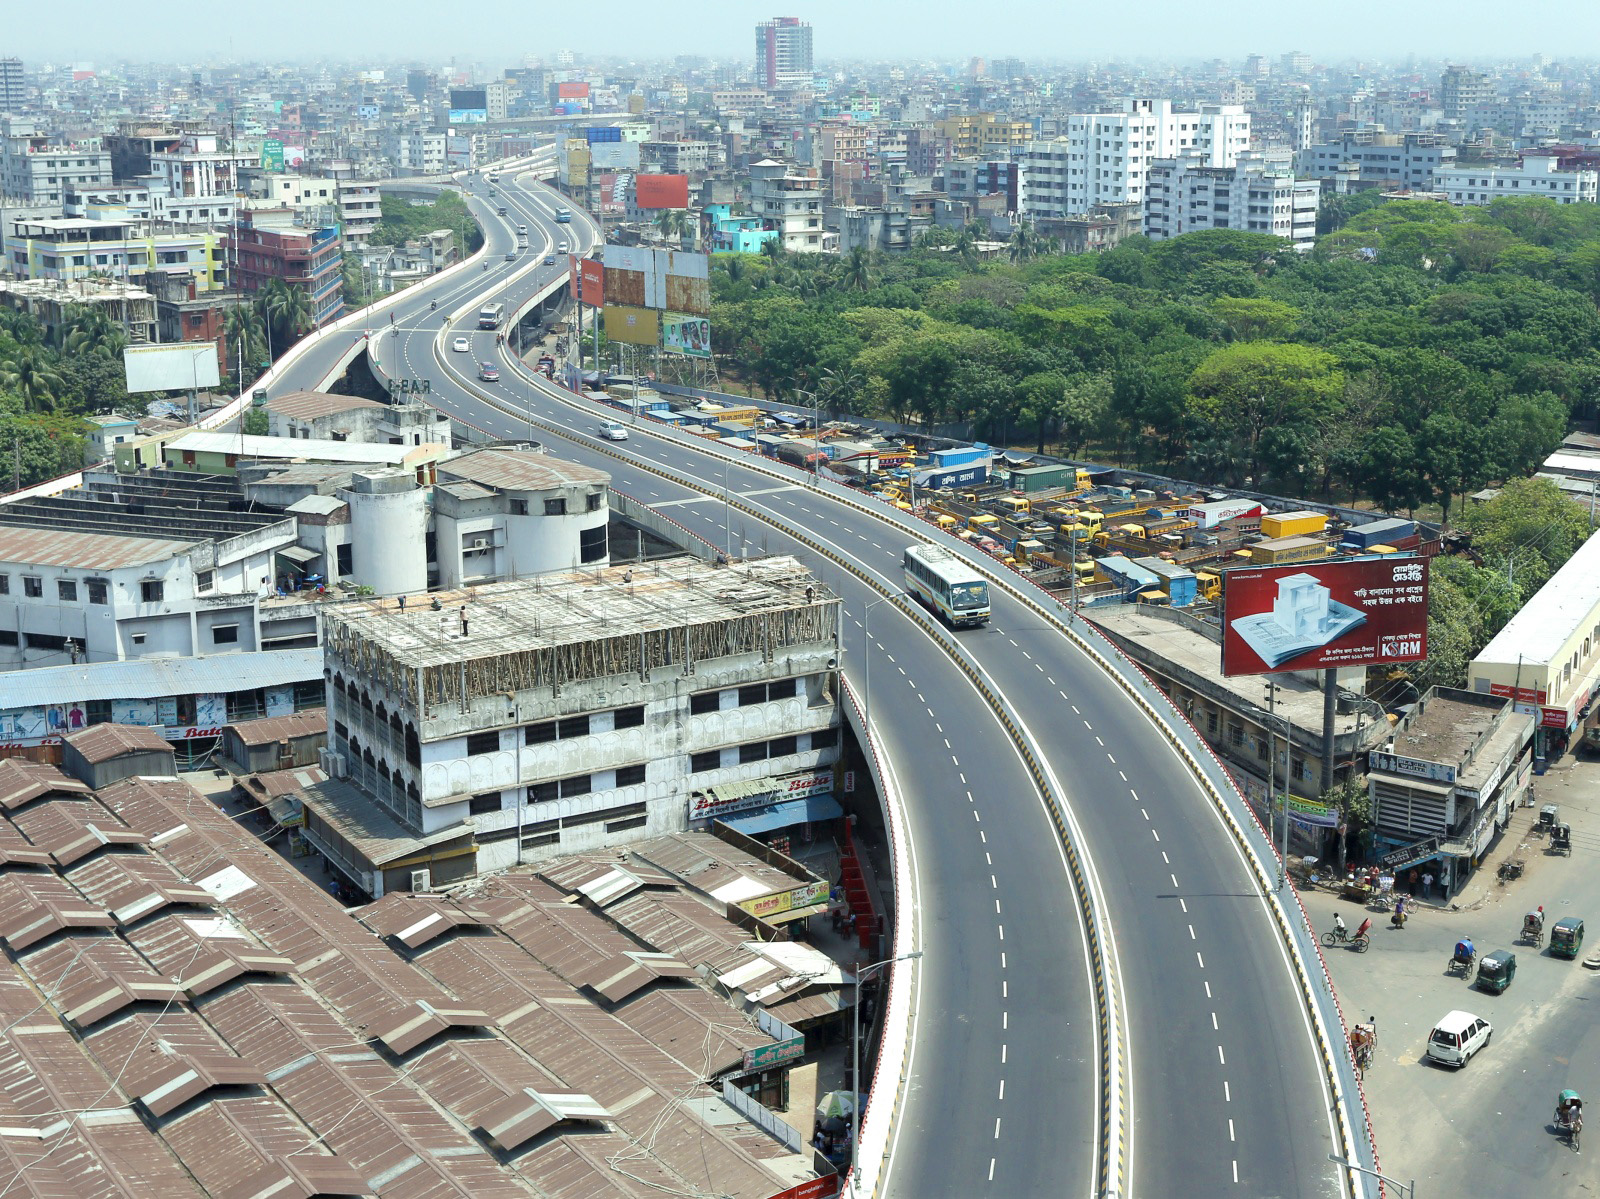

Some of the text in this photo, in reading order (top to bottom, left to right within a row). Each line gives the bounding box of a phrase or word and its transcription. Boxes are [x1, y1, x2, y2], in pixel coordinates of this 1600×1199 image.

[1353, 588, 1367, 598] বাড়ি
[1368, 588, 1394, 596] বানানোর
[1362, 598, 1377, 606] সহজ
[1394, 596, 1406, 604] এক
[1381, 640, 1421, 657] KSRM
[183, 727, 224, 738] Bata
[787, 775, 831, 791] Bata
[798, 1182, 825, 1196] banglalink
